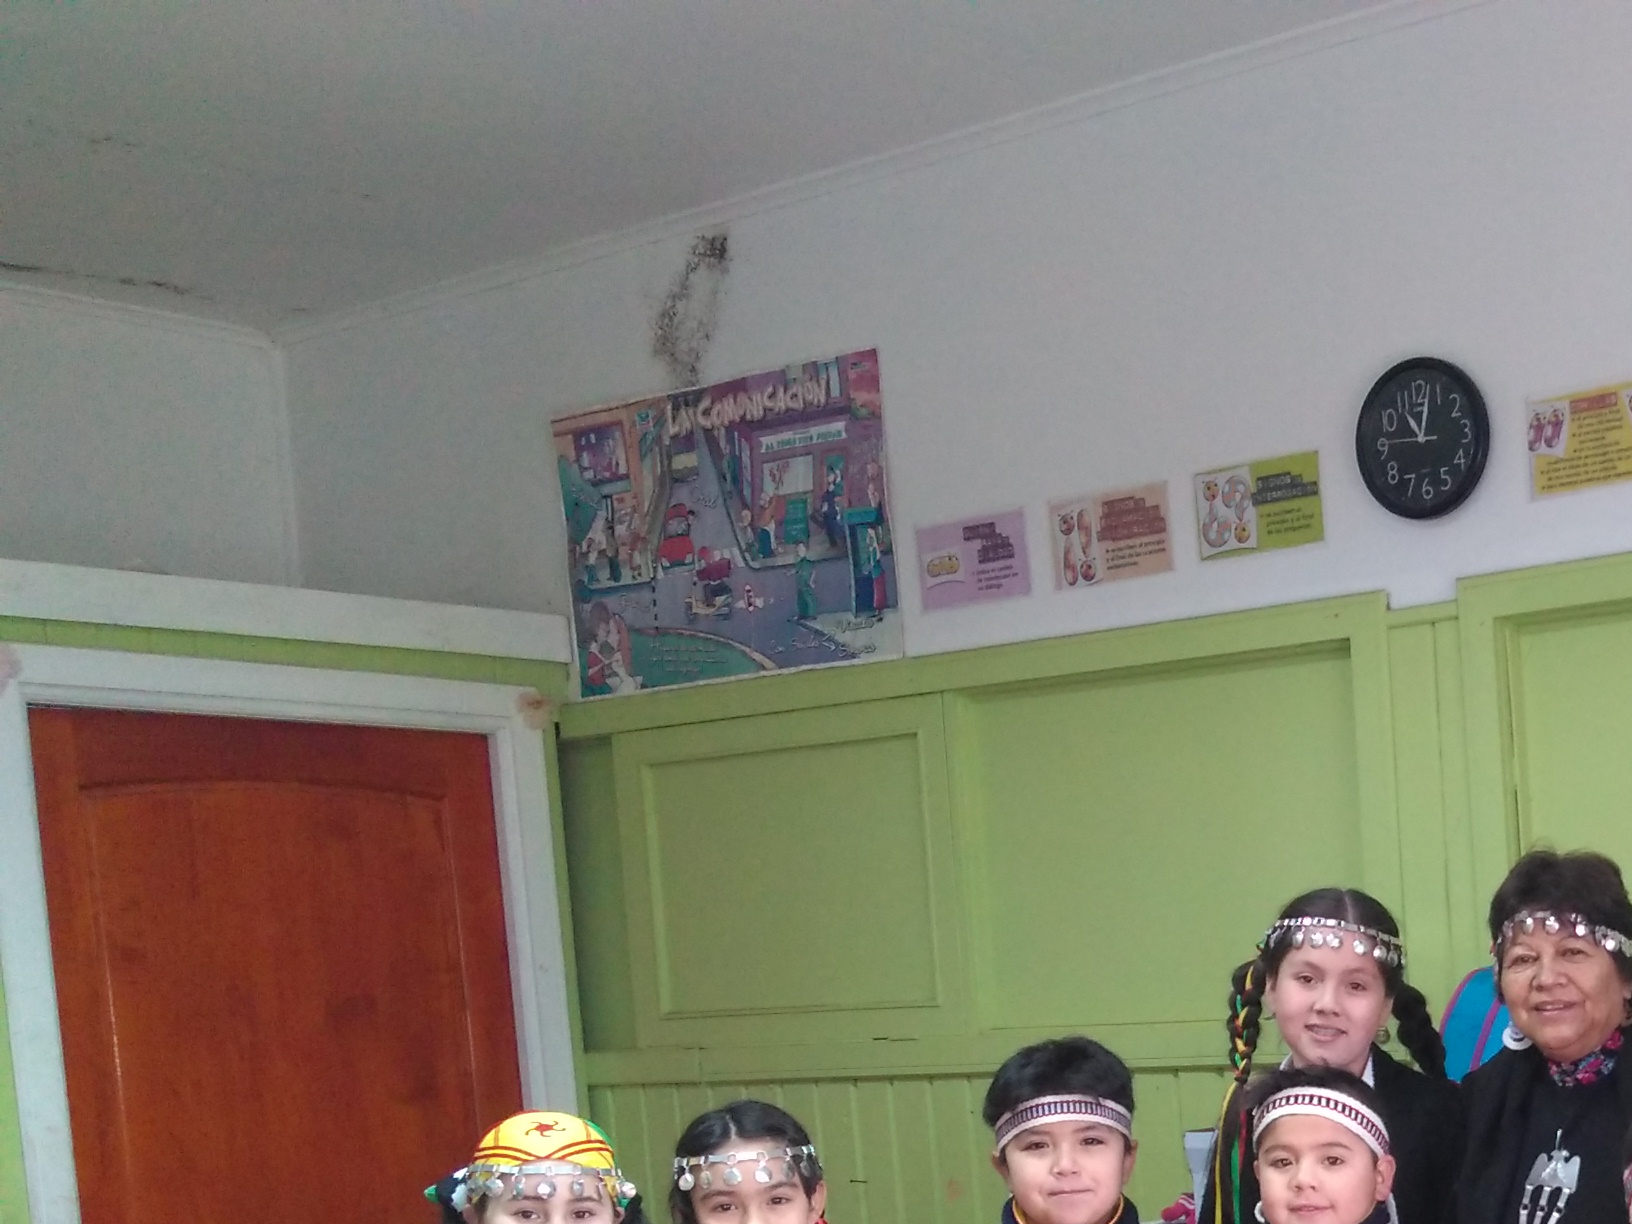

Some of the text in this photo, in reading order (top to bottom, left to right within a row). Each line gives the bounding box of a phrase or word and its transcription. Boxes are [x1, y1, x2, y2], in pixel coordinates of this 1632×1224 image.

[1397, 390, 1409, 414] 11
[1411, 380, 1426, 404] 12
[1436, 384, 1441, 405] 1
[666, 373, 828, 438] LA COMUNICACIÓN
[1449, 394, 1461, 418] 2
[1381, 408, 1397, 433] 10
[1460, 419, 1471, 443] 3
[1377, 437, 1389, 460] 9
[1453, 448, 1466, 472] 4
[1387, 461, 1399, 485] 8
[1440, 467, 1452, 490] 5
[1403, 474, 1416, 497] 7
[1422, 477, 1434, 500] 6
